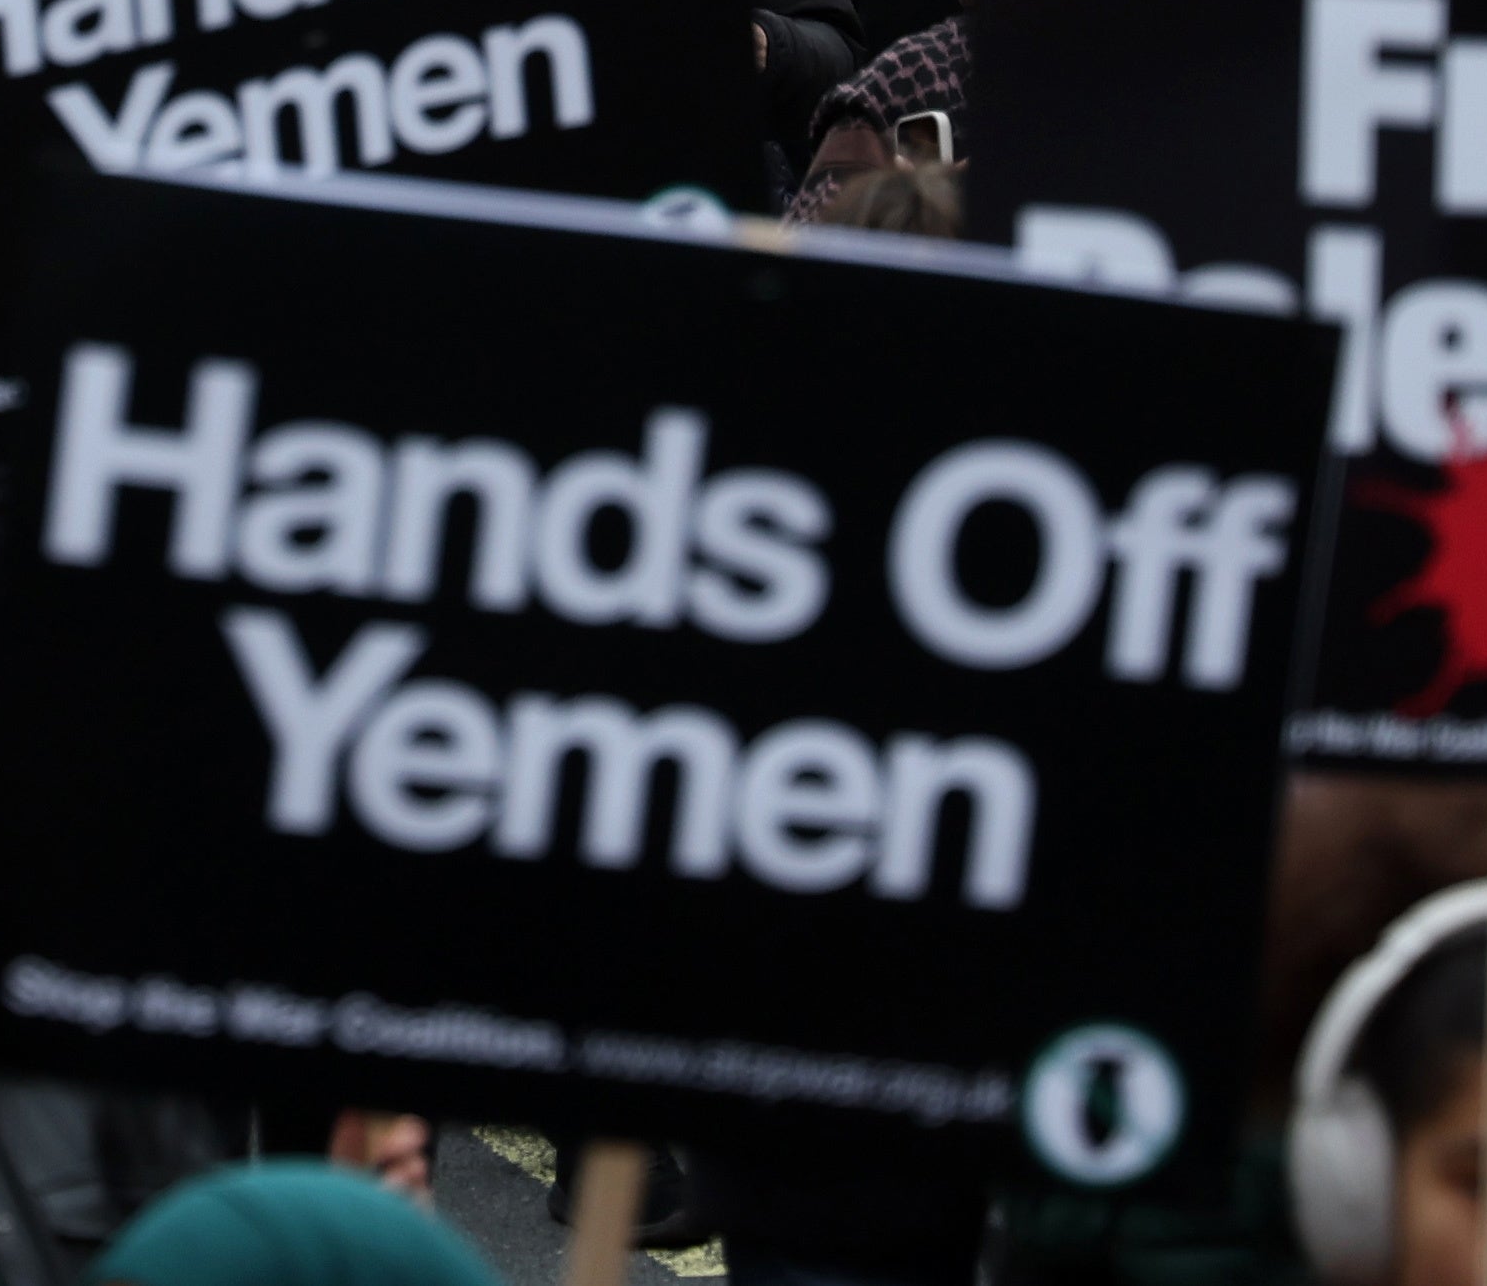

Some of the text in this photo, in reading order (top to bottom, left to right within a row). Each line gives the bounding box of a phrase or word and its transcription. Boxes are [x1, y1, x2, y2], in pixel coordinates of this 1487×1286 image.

[40, 338, 1301, 693] Hands Off
[218, 608, 1040, 914] Yemen
